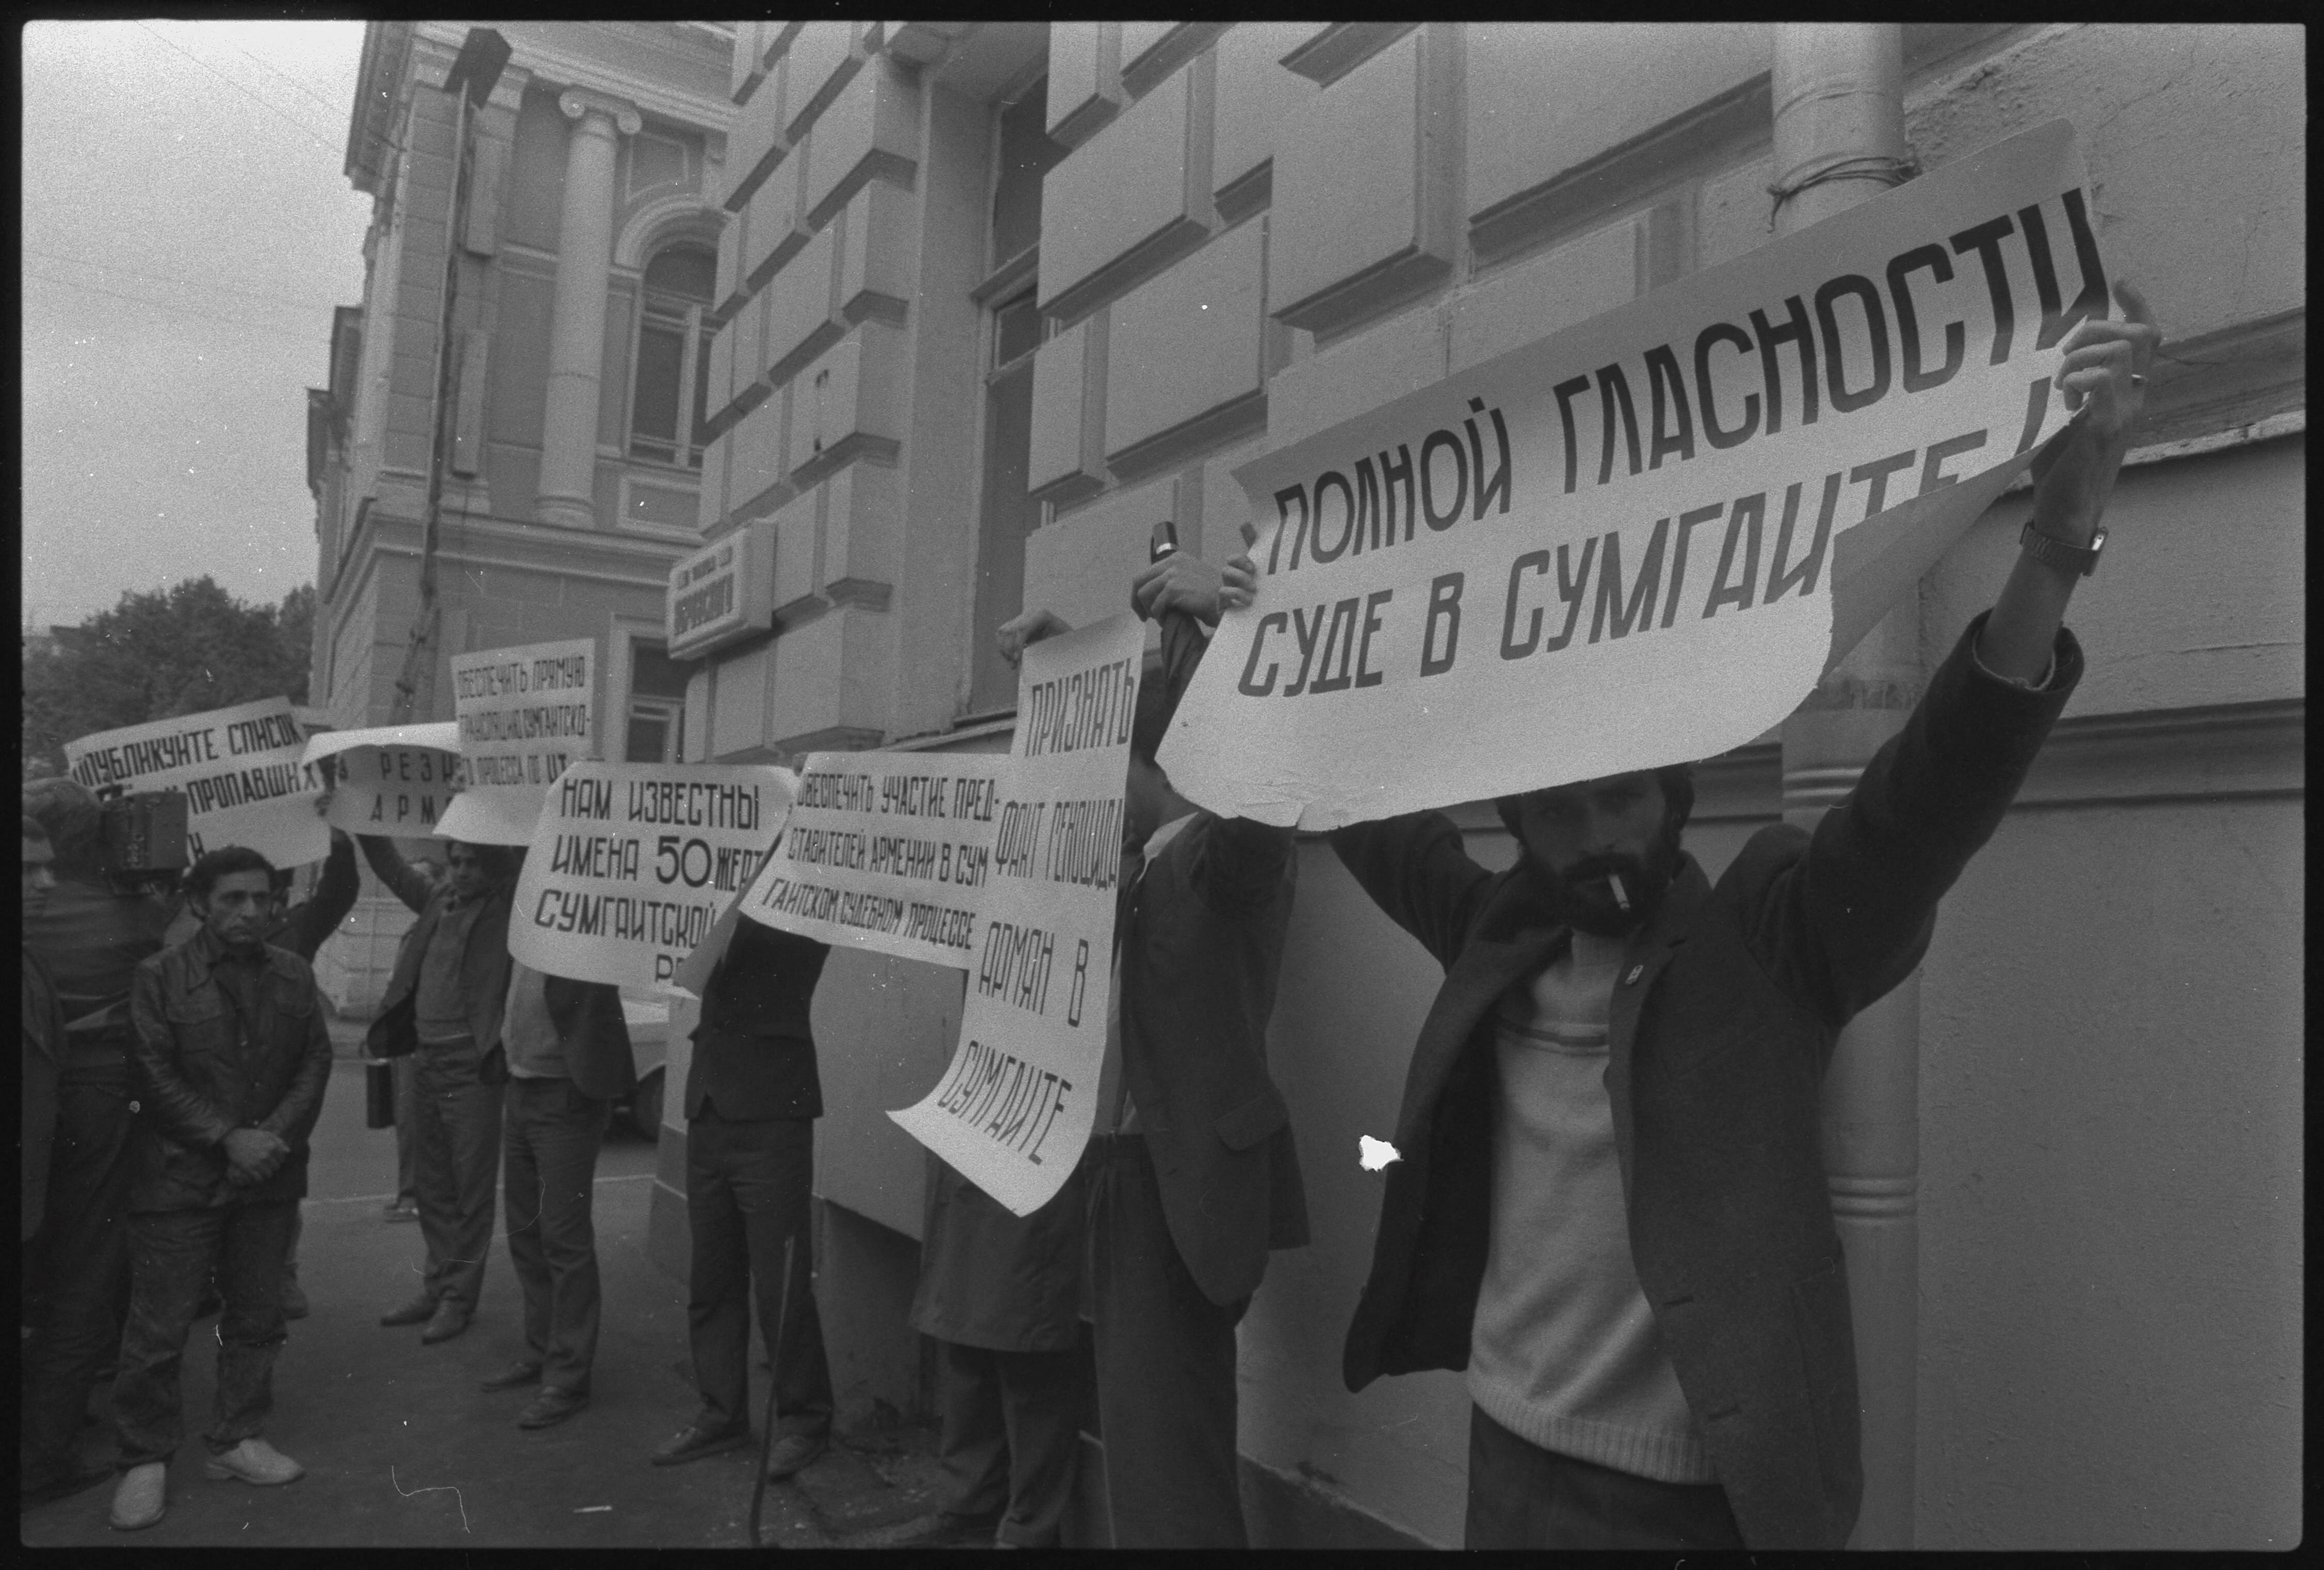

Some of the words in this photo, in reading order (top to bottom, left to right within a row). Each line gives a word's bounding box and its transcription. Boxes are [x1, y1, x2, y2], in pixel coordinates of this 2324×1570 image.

[1267, 396, 1512, 575] ПОЛНОЙ
[1553, 186, 2110, 494] ГЛАСНОСТИ
[1238, 589, 1393, 697] СУДЕ
[1420, 572, 1465, 677] В
[227, 713, 303, 755] СПИСОК
[1025, 658, 1134, 757] ПРИЗНАТЬ
[187, 761, 317, 814] ПРОПАВШИХ
[370, 793, 452, 824] АРМ
[562, 778, 611, 820] НАМ
[628, 781, 759, 830] ИЗВЕСТНЫ
[882, 776, 948, 818] УЧАСТИЕ
[551, 835, 639, 881] ИМЕНА
[656, 836, 712, 887] 50
[715, 847, 764, 892] ЖЕРТ
[788, 827, 867, 870] СТАВИТЕЛЕЙ
[869, 836, 936, 880] АРМЕНИИ
[939, 843, 951, 882] В
[1045, 798, 1124, 891] ГЕНОЦИДА
[840, 891, 903, 935] СУДЕБНОМ
[903, 902, 976, 950] ПРОЦЕССЕ
[978, 921, 1055, 1016] АРМЯН
[1067, 938, 1089, 1027] В
[937, 1040, 1072, 1166] СУМГАИТЕ
